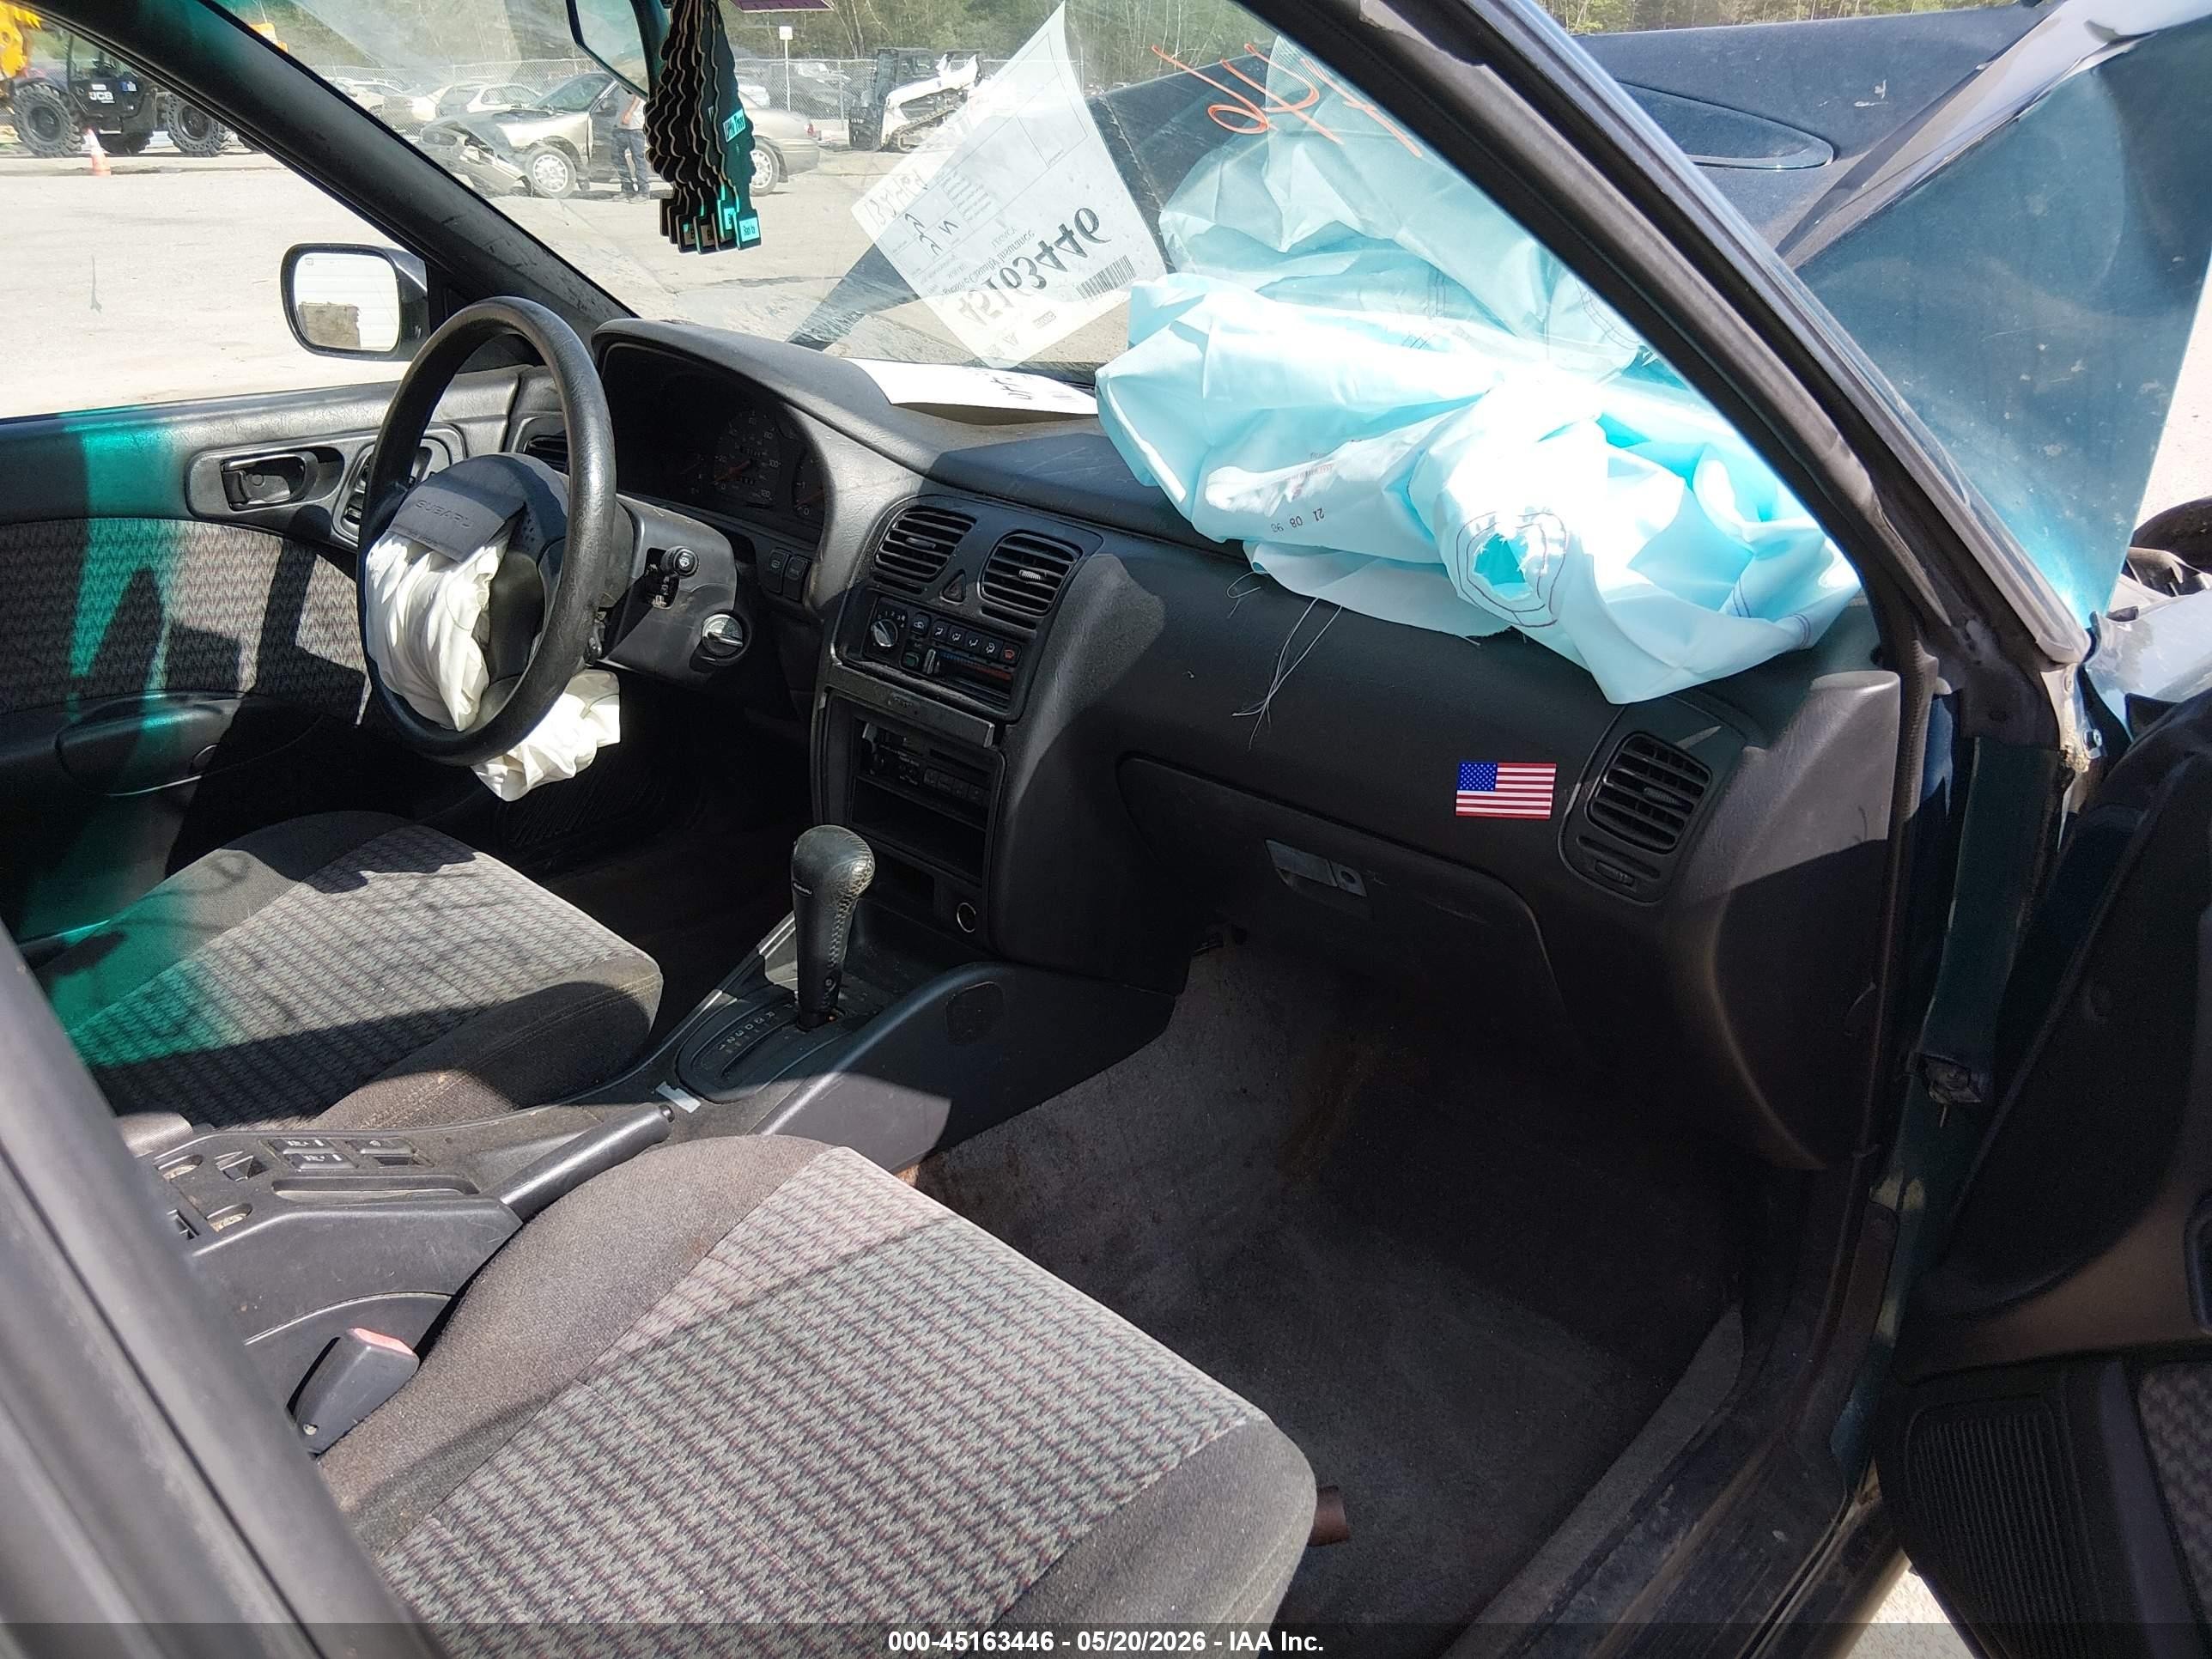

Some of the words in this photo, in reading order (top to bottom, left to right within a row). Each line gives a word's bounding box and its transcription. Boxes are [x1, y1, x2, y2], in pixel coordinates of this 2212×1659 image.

[88, 91, 113, 100] JCB
[415, 500, 472, 528] SUBARU
[1312, 507, 1325, 522] 21
[1289, 515, 1303, 528] 08
